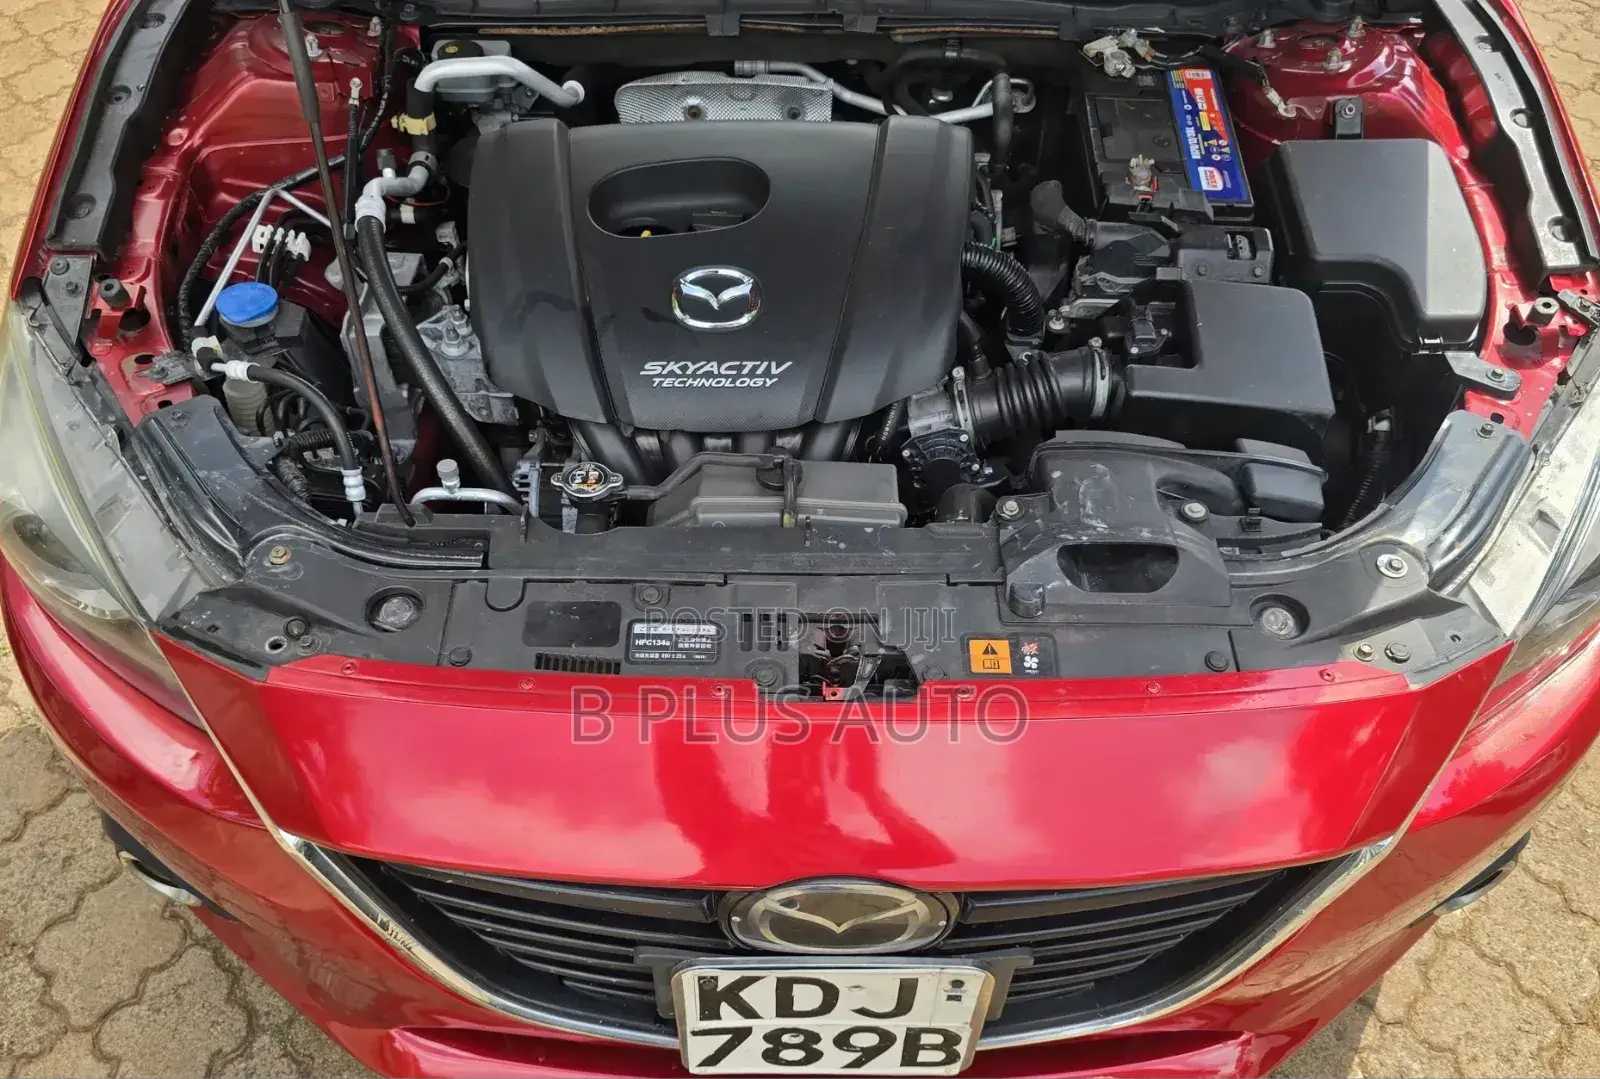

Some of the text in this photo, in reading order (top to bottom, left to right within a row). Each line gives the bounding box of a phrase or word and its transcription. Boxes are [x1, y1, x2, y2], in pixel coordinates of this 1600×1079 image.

[639, 361, 793, 376] SKYACTIV
[652, 377, 778, 388] TECHNOLOGY
[698, 975, 919, 1021] KDJ
[690, 1026, 962, 1069] 789B
